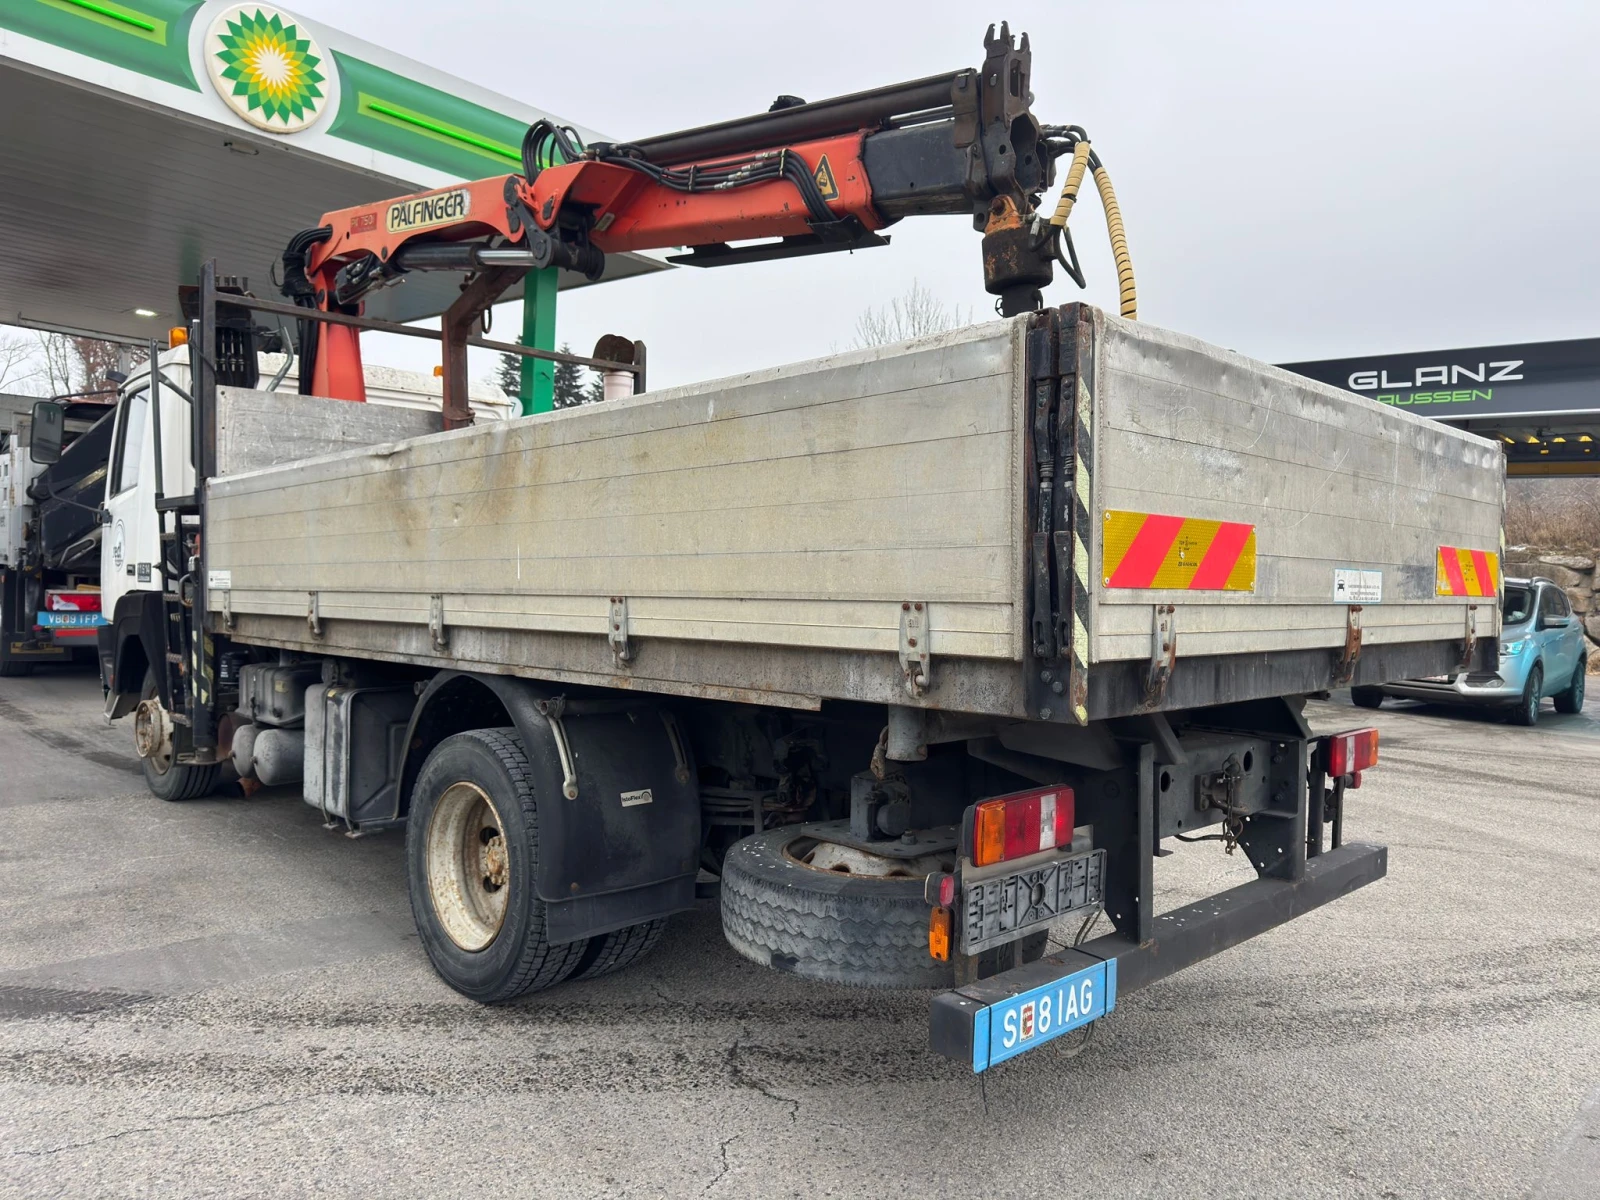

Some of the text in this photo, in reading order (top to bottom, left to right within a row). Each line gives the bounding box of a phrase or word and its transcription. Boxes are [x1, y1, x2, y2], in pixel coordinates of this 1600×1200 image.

[390, 193, 464, 229] PALFINGER
[1347, 359, 1524, 391] GLANZ
[1376, 389, 1493, 406] AUSSEN
[1002, 1008, 1017, 1049] S
[1038, 995, 1052, 1034] 8
